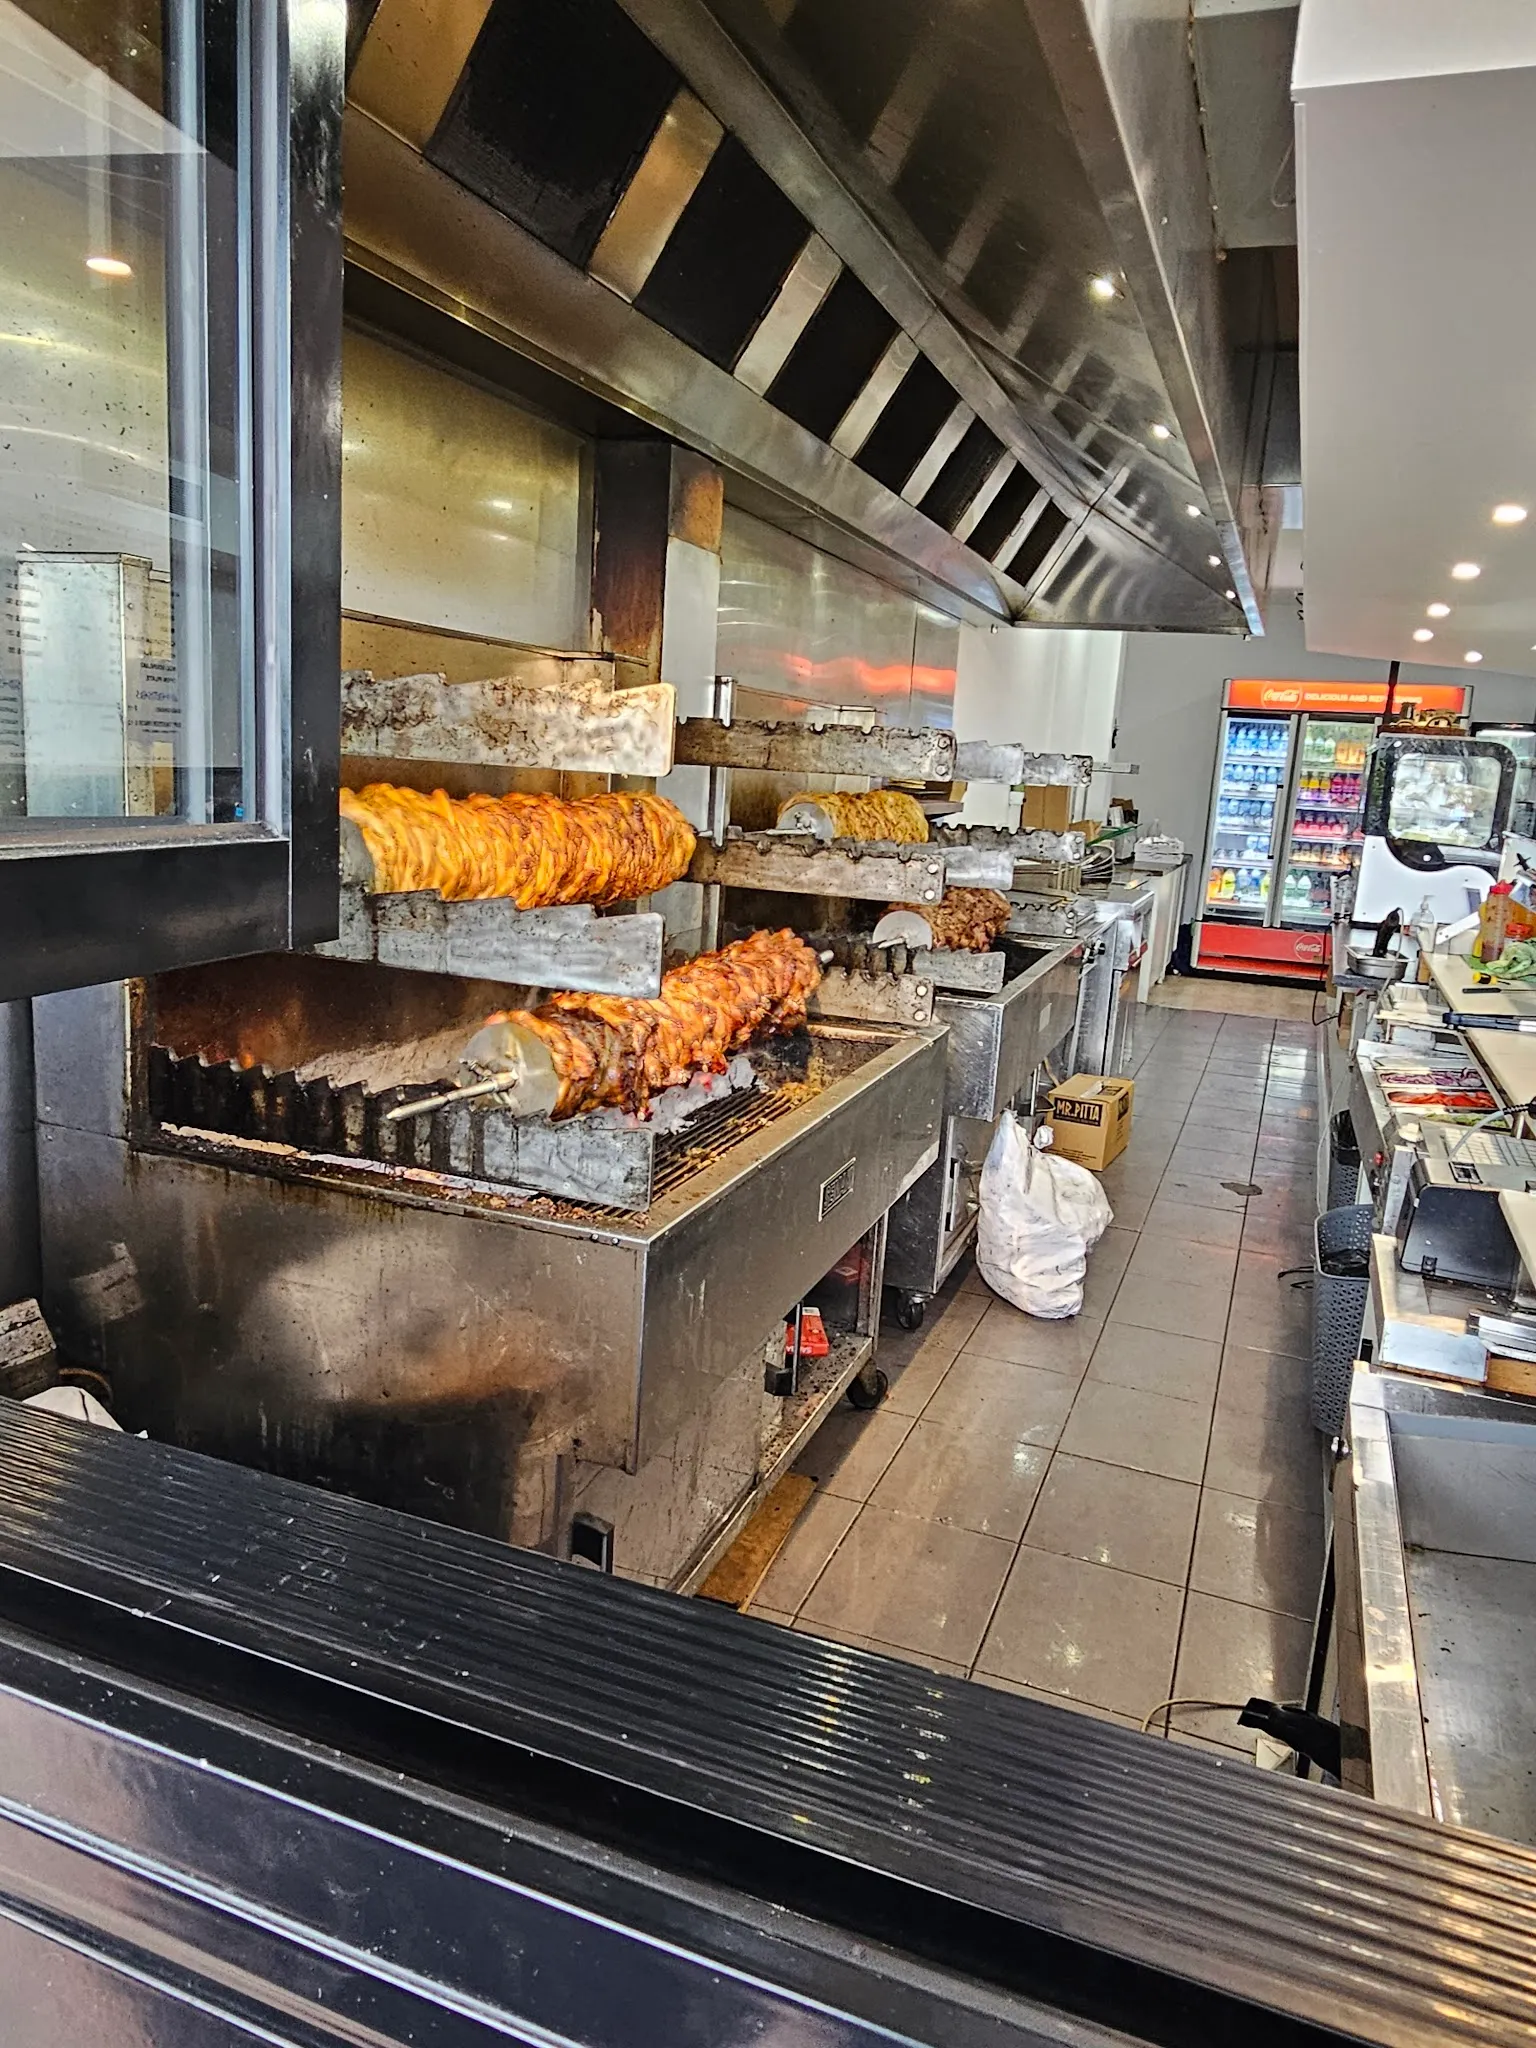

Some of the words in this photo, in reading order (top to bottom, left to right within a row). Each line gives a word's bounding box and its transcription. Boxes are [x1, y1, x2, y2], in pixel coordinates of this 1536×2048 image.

[1264, 689, 1299, 702] Coca-Cola
[1304, 693, 1349, 702] DELICIOUS
[1350, 694, 1367, 703] AND
[1296, 943, 1321, 953] Coca-Cola
